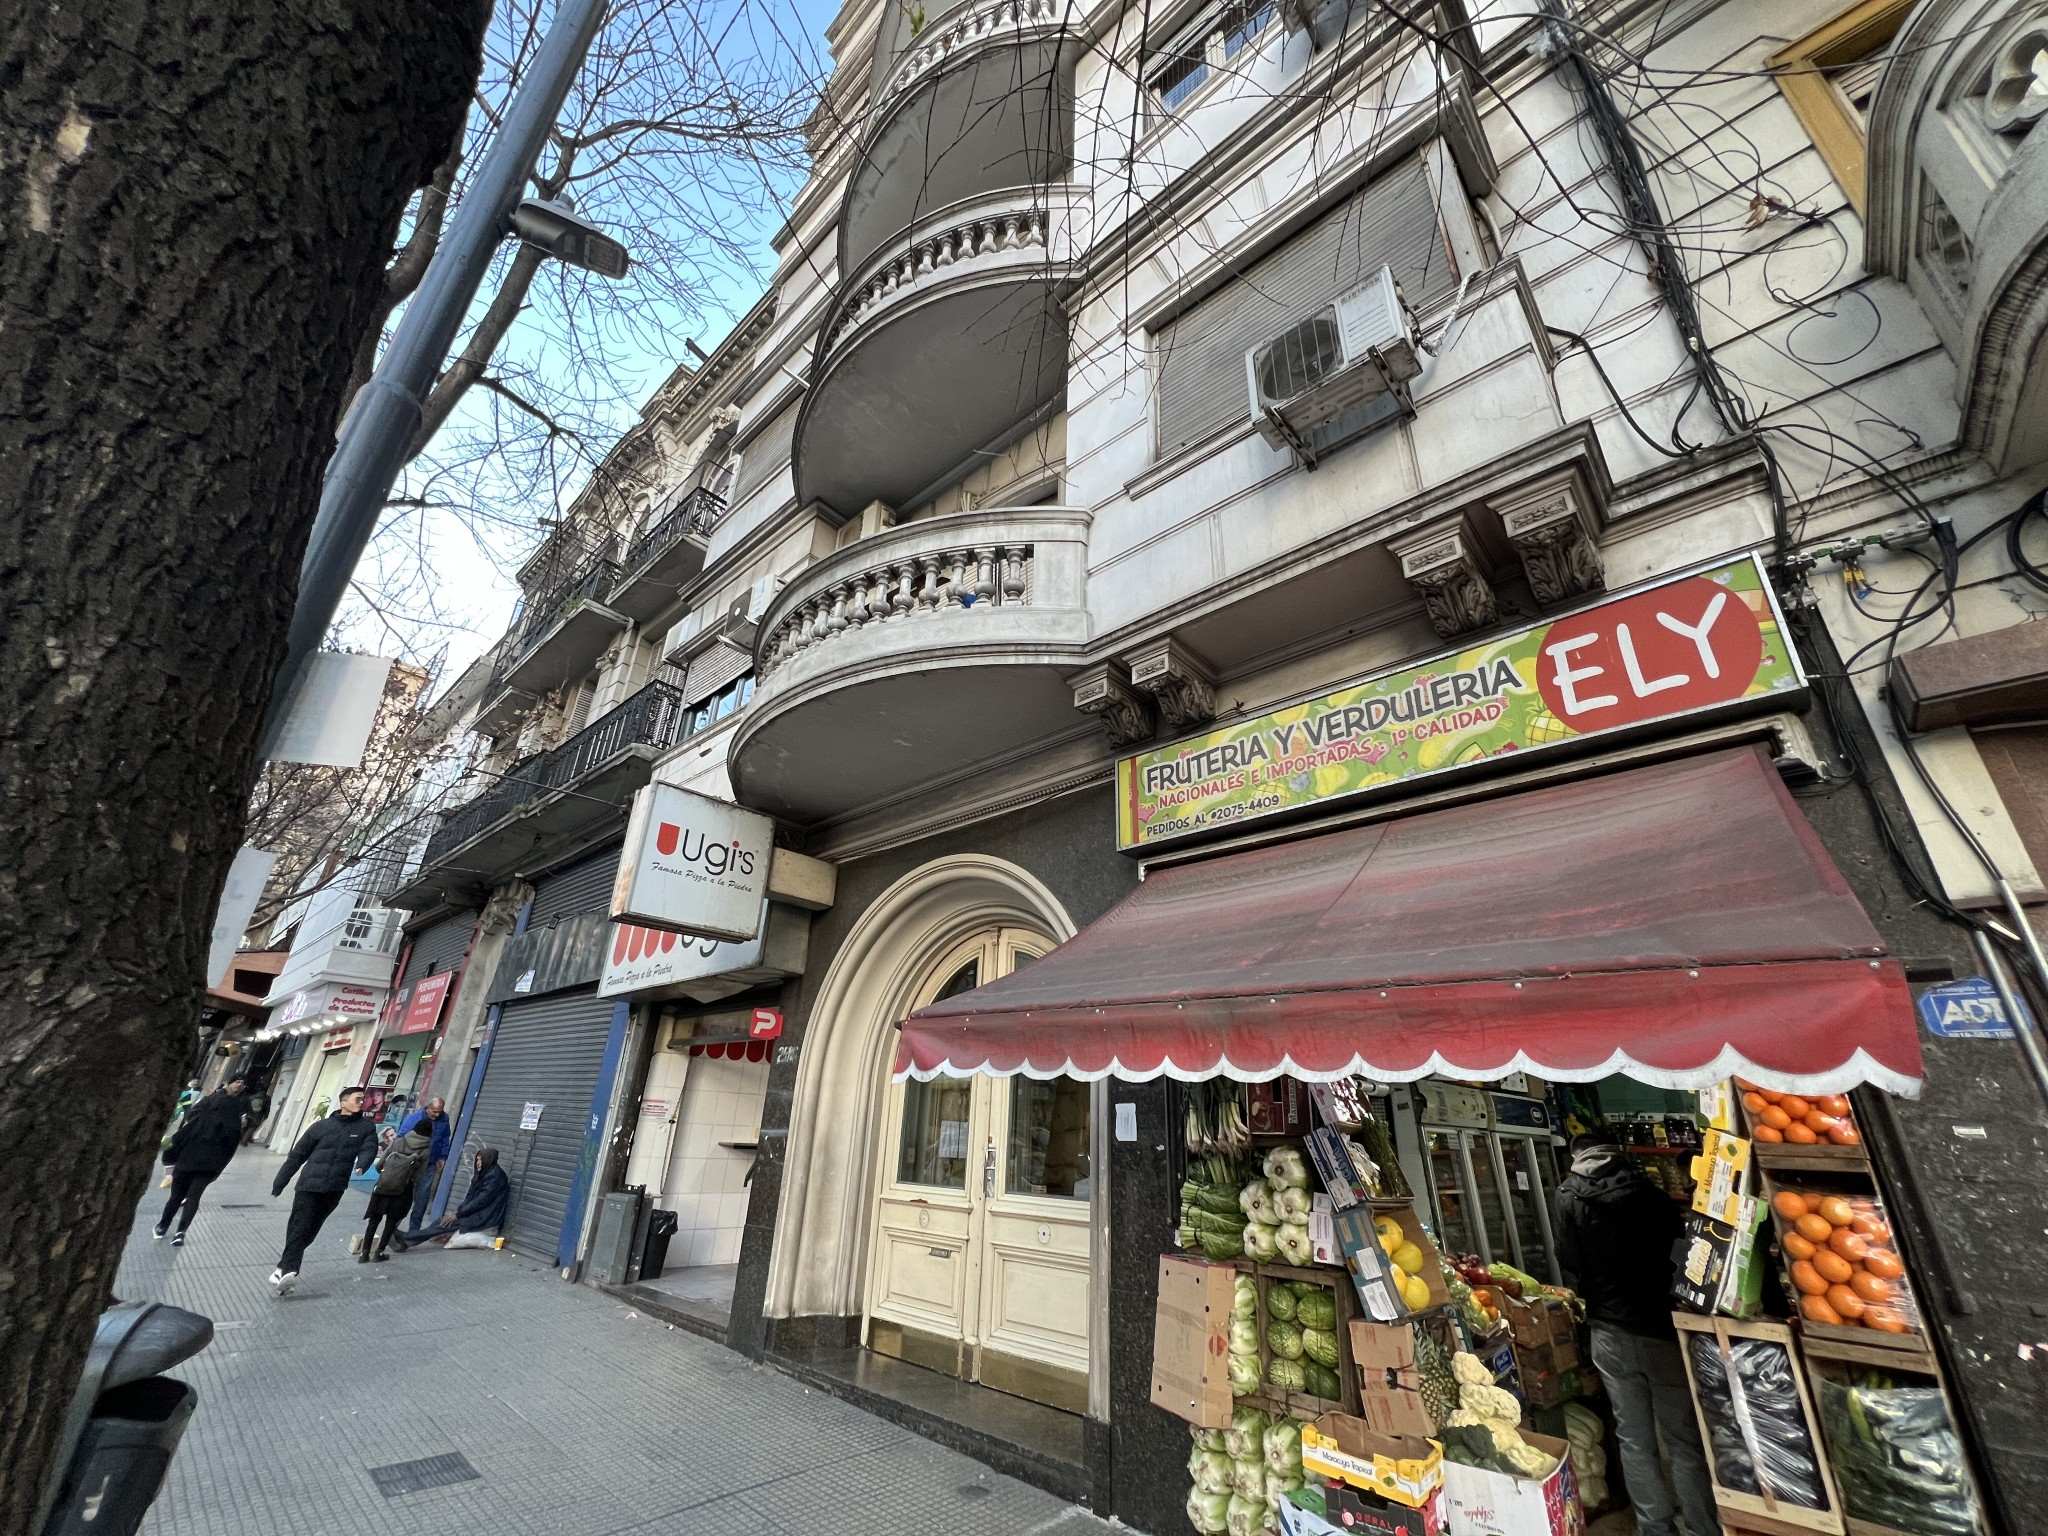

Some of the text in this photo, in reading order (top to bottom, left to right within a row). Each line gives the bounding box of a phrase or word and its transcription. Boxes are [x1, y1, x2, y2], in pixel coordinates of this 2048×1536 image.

[1545, 592, 1727, 716] ELY
[1146, 659, 1523, 794] FRUTERIA Y VERDULERIA
[1159, 773, 1244, 809] NACIONALES
[1251, 769, 1260, 785] E
[1266, 738, 1373, 780] IMPORTADAS
[1414, 703, 1501, 740] CALIDAD
[1146, 816, 1190, 837] PEDIDOS
[1194, 812, 1207, 825] AL
[682, 828, 755, 876] Ugi's
[651, 861, 683, 876] Famosa
[685, 869, 707, 882] Pizza
[717, 878, 725, 886] la
[728, 880, 753, 893] Piedra
[1943, 998, 2007, 1025] ADT
